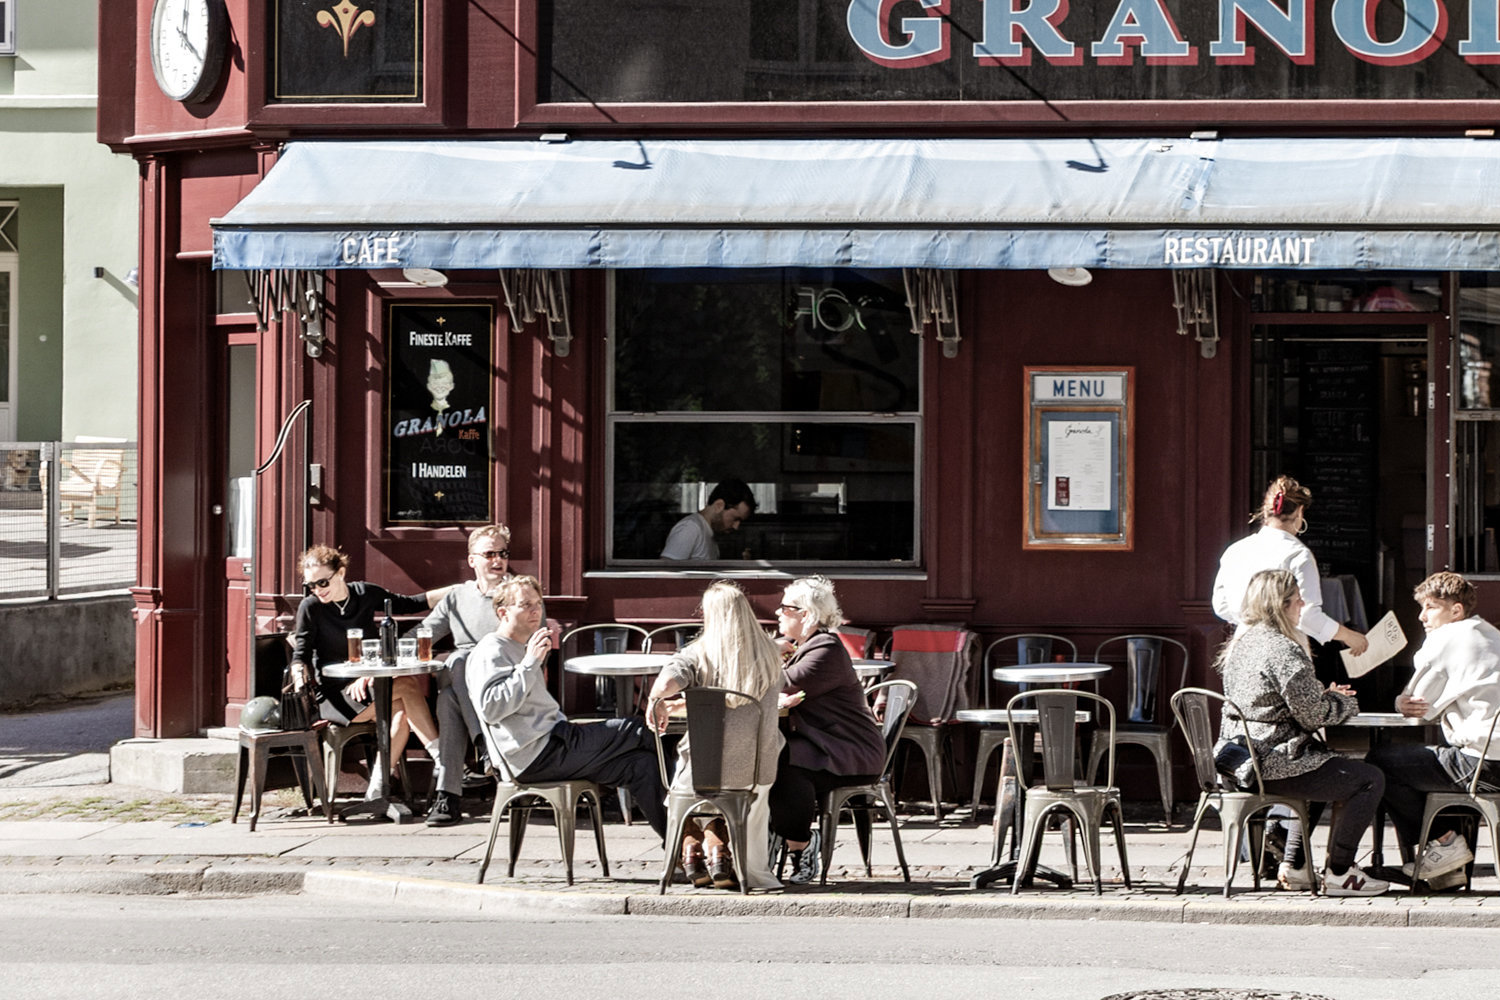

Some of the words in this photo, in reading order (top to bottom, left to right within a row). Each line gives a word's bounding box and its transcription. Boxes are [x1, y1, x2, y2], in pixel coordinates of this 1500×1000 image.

[342, 231, 400, 264] CAFÉ
[1164, 236, 1315, 264] RESTAURANT
[409, 331, 443, 346] FINESTE
[445, 331, 472, 346] KAFFE
[1053, 379, 1104, 397] MENU
[393, 406, 486, 437] GRANOLA
[459, 428, 480, 439] Kaffe
[411, 462, 417, 478] I
[418, 462, 467, 478] HANDELEN
